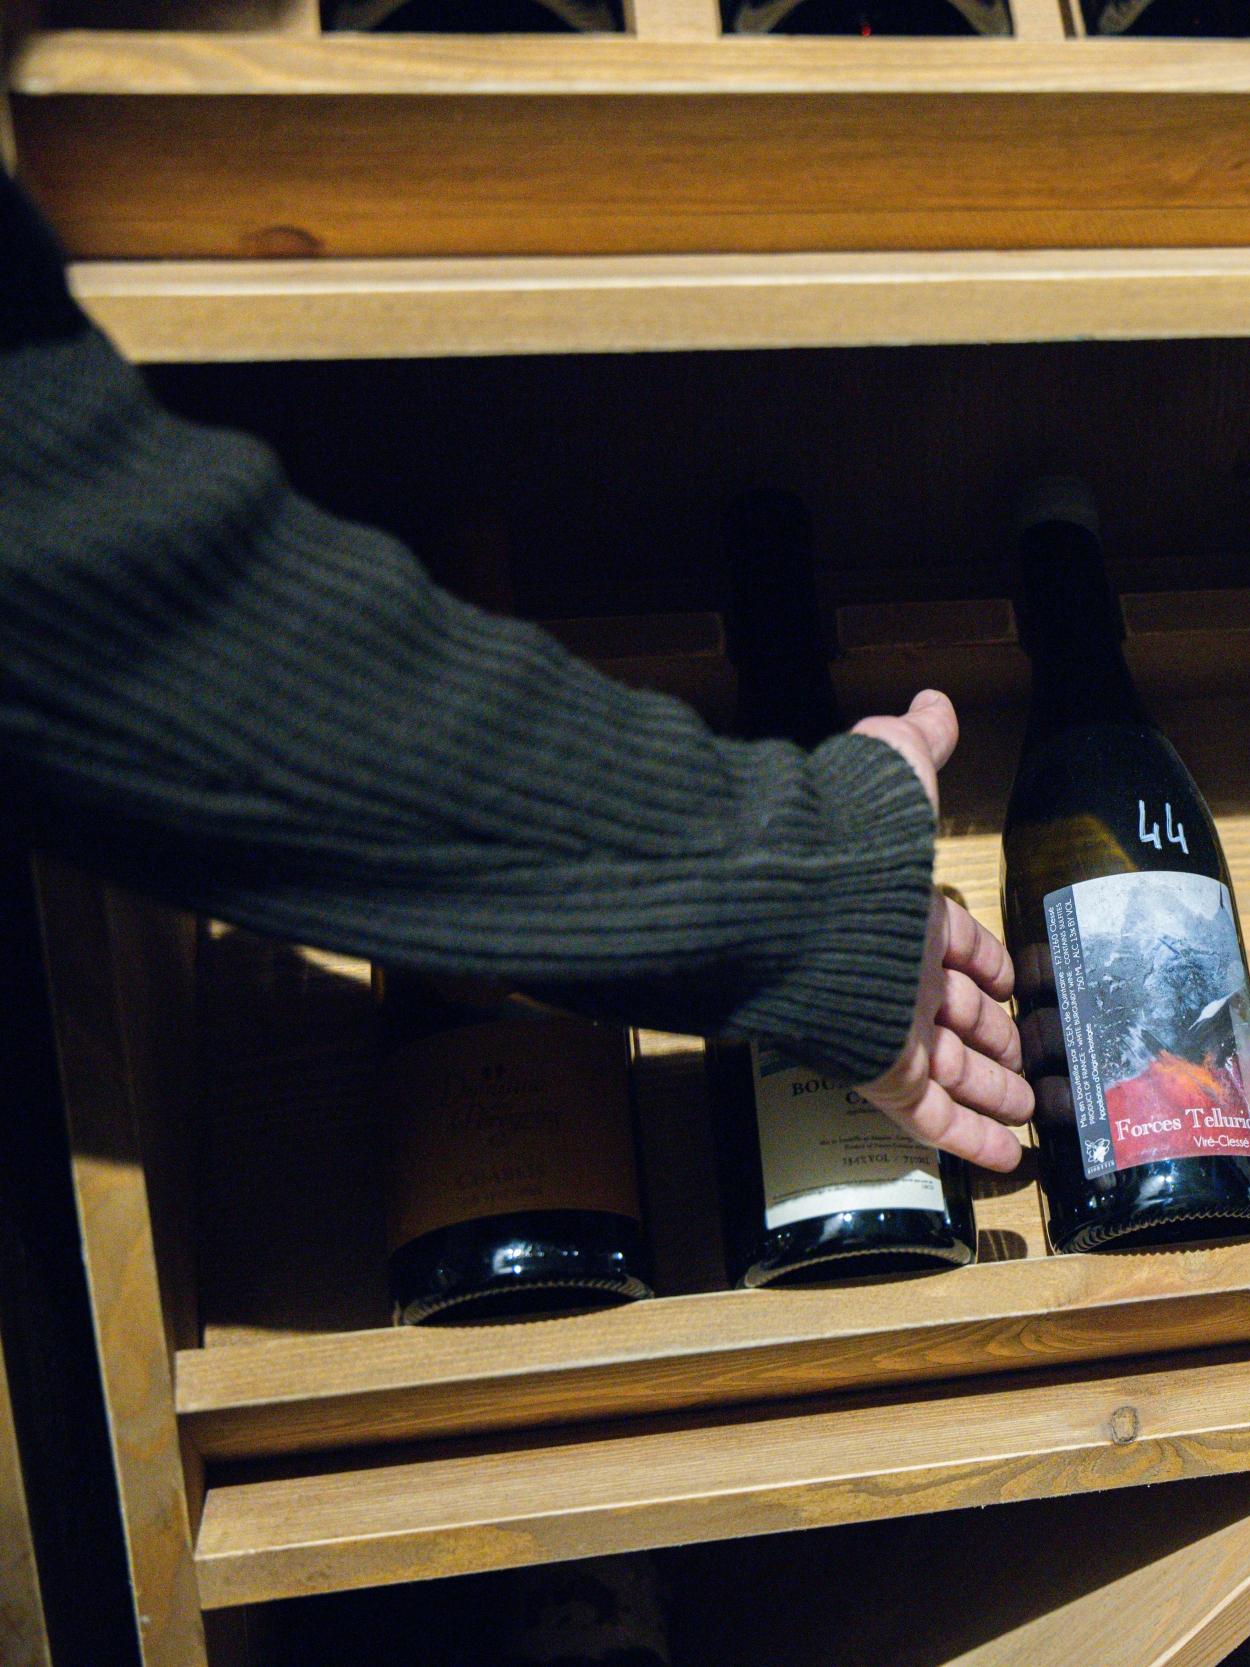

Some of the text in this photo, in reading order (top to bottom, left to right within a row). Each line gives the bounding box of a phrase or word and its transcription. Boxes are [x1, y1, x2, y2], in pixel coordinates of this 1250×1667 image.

[1138, 799, 1189, 854] 44
[1056, 902, 1064, 929] SULFITES
[1065, 899, 1073, 915] VOL
[1067, 915, 1075, 927] BY
[1061, 930, 1070, 964] CONTAINS
[1072, 943, 1080, 958] ALC
[1075, 964, 1082, 975] ML
[1059, 972, 1069, 1009] Quintaine
[1077, 977, 1085, 991] 750
[1064, 1012, 1071, 1022] de
[1069, 989, 1080, 1025] BURGUNDY
[1066, 1025, 1074, 1047] SCEA
[1075, 1026, 1083, 1045] WHITE
[1079, 1051, 1088, 1078] FRANCE
[1073, 1065, 1083, 1099] bouteille
[1084, 1080, 1090, 1089] OF
[1079, 1102, 1085, 1111] en
[1086, 1093, 1095, 1124] PRODUCT
[1095, 1083, 1107, 1120] Appellation
[1115, 1117, 1182, 1142] Forces
[1193, 1134, 1250, 1149] Viré-Clessé
